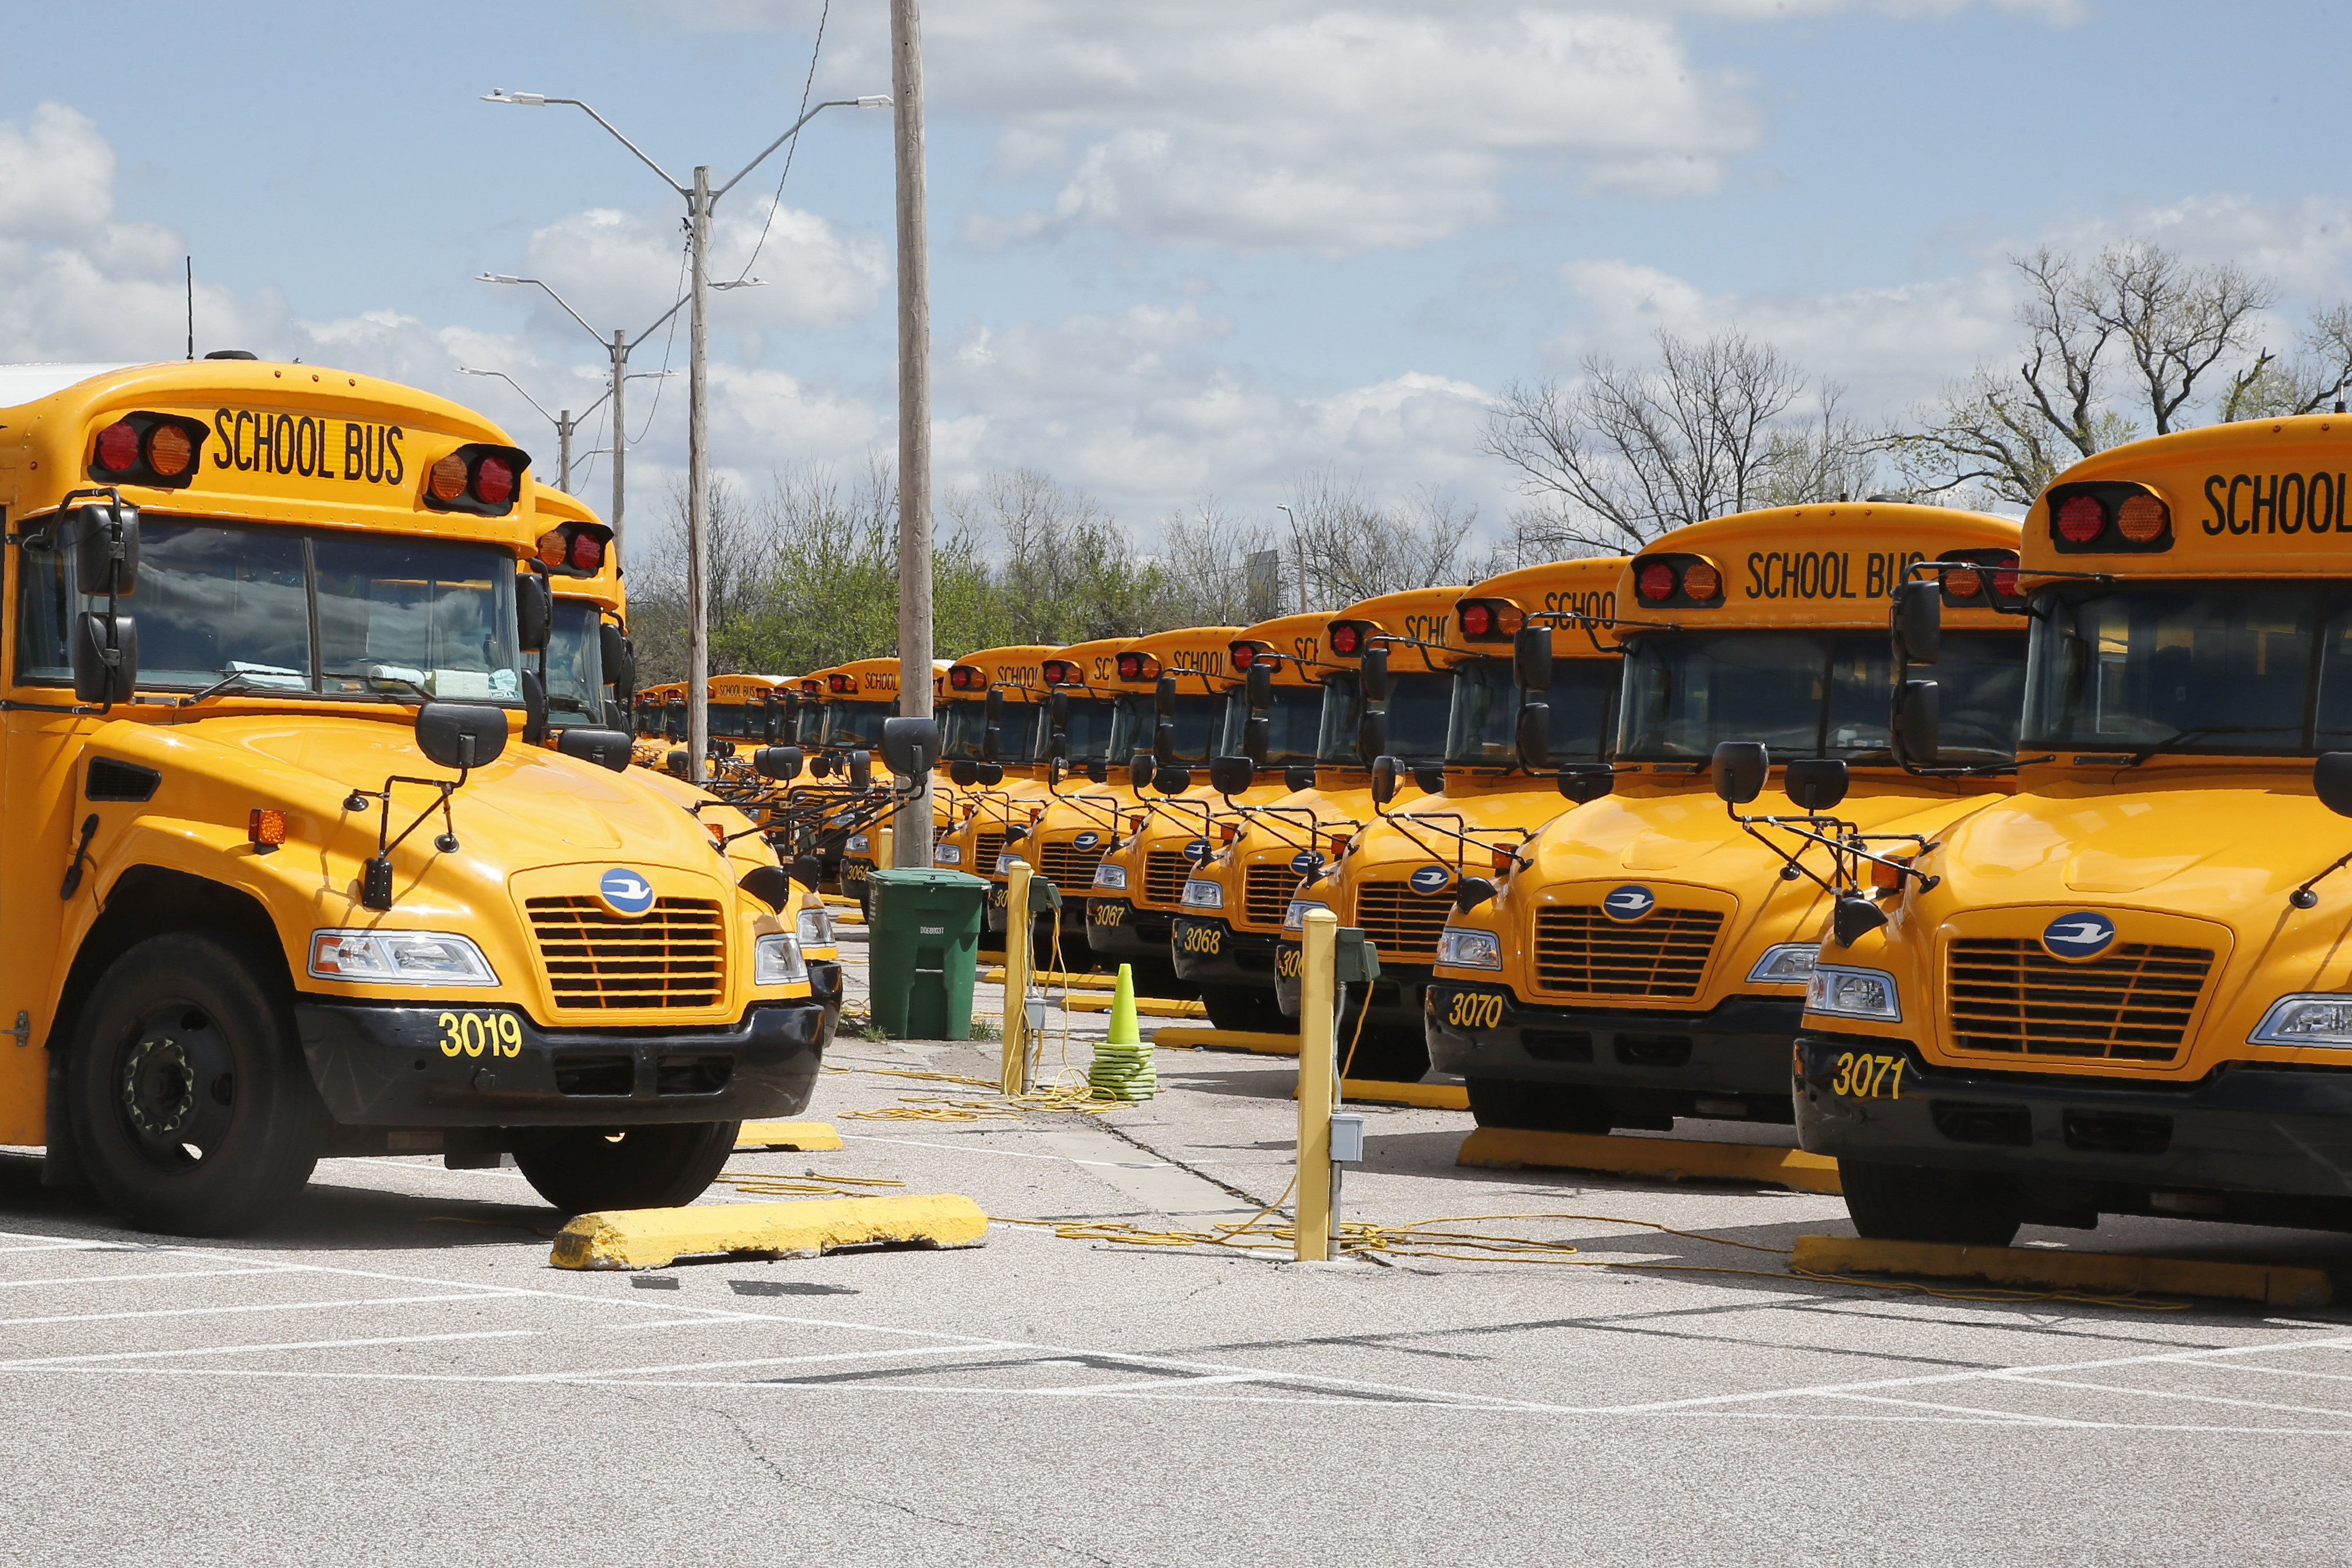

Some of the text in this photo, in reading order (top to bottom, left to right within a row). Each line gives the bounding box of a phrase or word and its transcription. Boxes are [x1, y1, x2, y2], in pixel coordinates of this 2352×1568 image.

[214, 408, 404, 485] SCHOOL BUS
[1746, 551, 1856, 599] SCHOOL
[1544, 591, 1615, 629] SCHOO
[720, 684, 755, 697] SCHOOL BUS
[864, 672, 898, 691] SCHOOL
[998, 666, 1038, 688] SCHOO
[995, 889, 1009, 908] 30
[1095, 904, 1125, 926] 3067
[1184, 927, 1220, 955] 3068
[1449, 993, 1502, 1028] 3070
[438, 1012, 521, 1058] 3019
[1833, 1051, 1906, 1100] 3071
